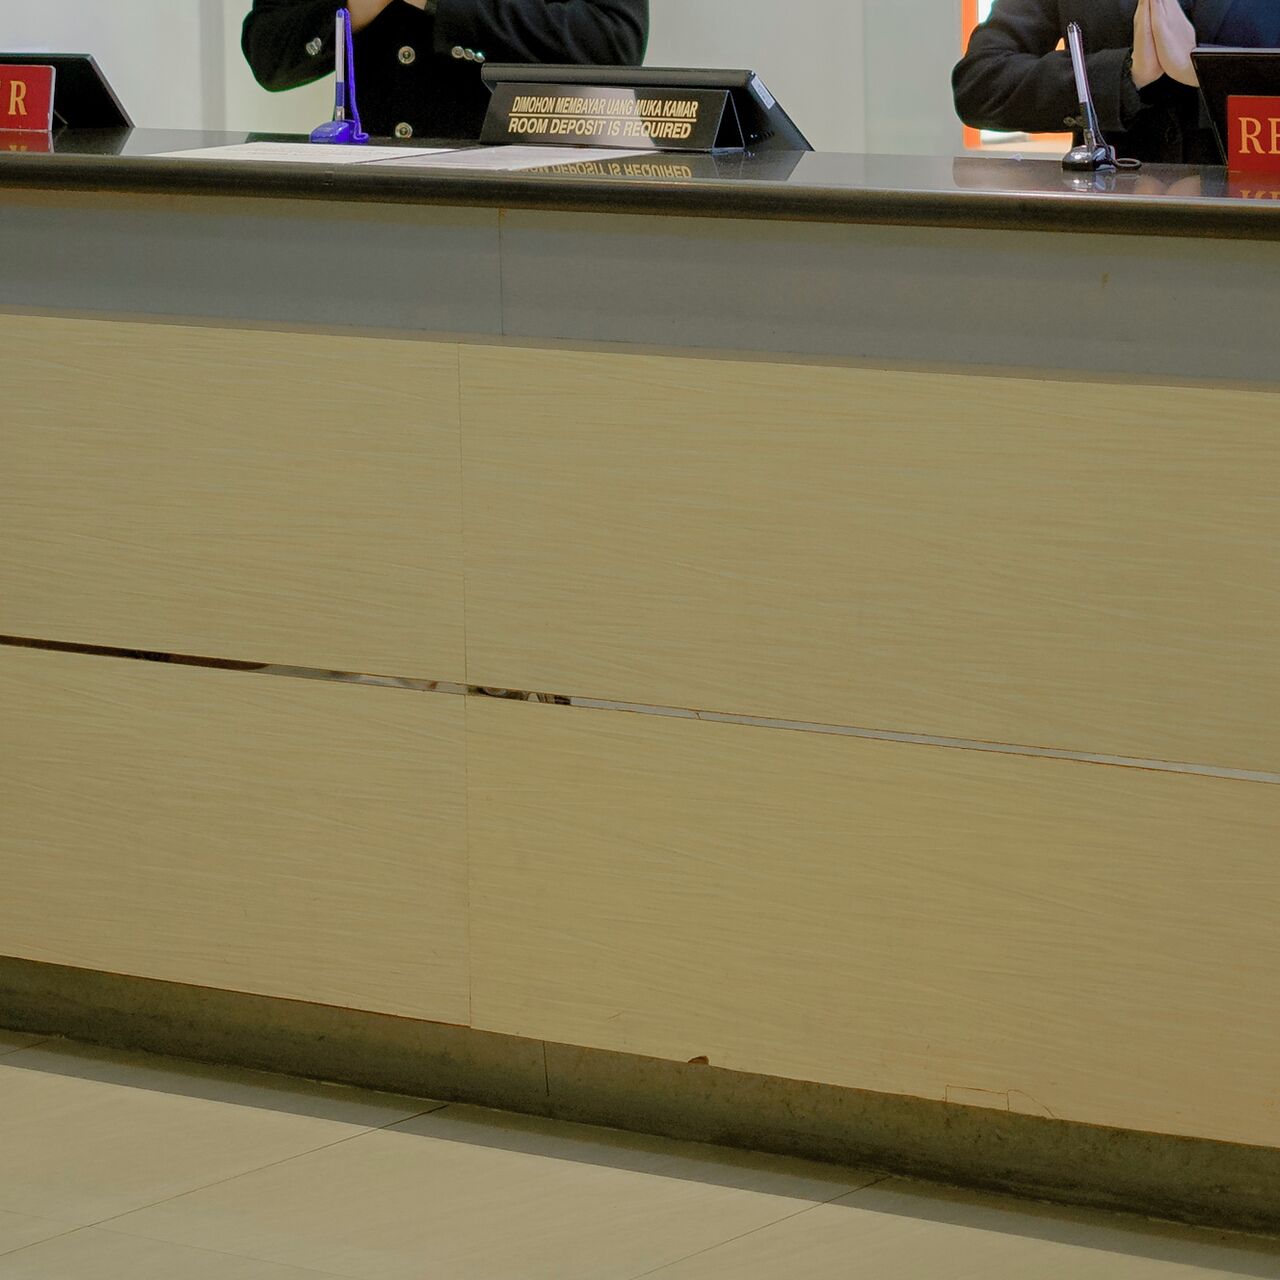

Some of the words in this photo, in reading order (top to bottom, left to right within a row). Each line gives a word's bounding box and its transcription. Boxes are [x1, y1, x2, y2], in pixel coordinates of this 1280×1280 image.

[511, 96, 557, 113] DIMOHON
[556, 97, 605, 115] MEMBAYAR
[606, 99, 634, 116] UANG
[635, 99, 663, 116] MUKA
[662, 101, 699, 118] KAMAR
[508, 117, 549, 134] ROOM
[549, 119, 606, 136] DEPOSIT
[607, 121, 621, 136] IS
[623, 122, 692, 139] REQUIRED
